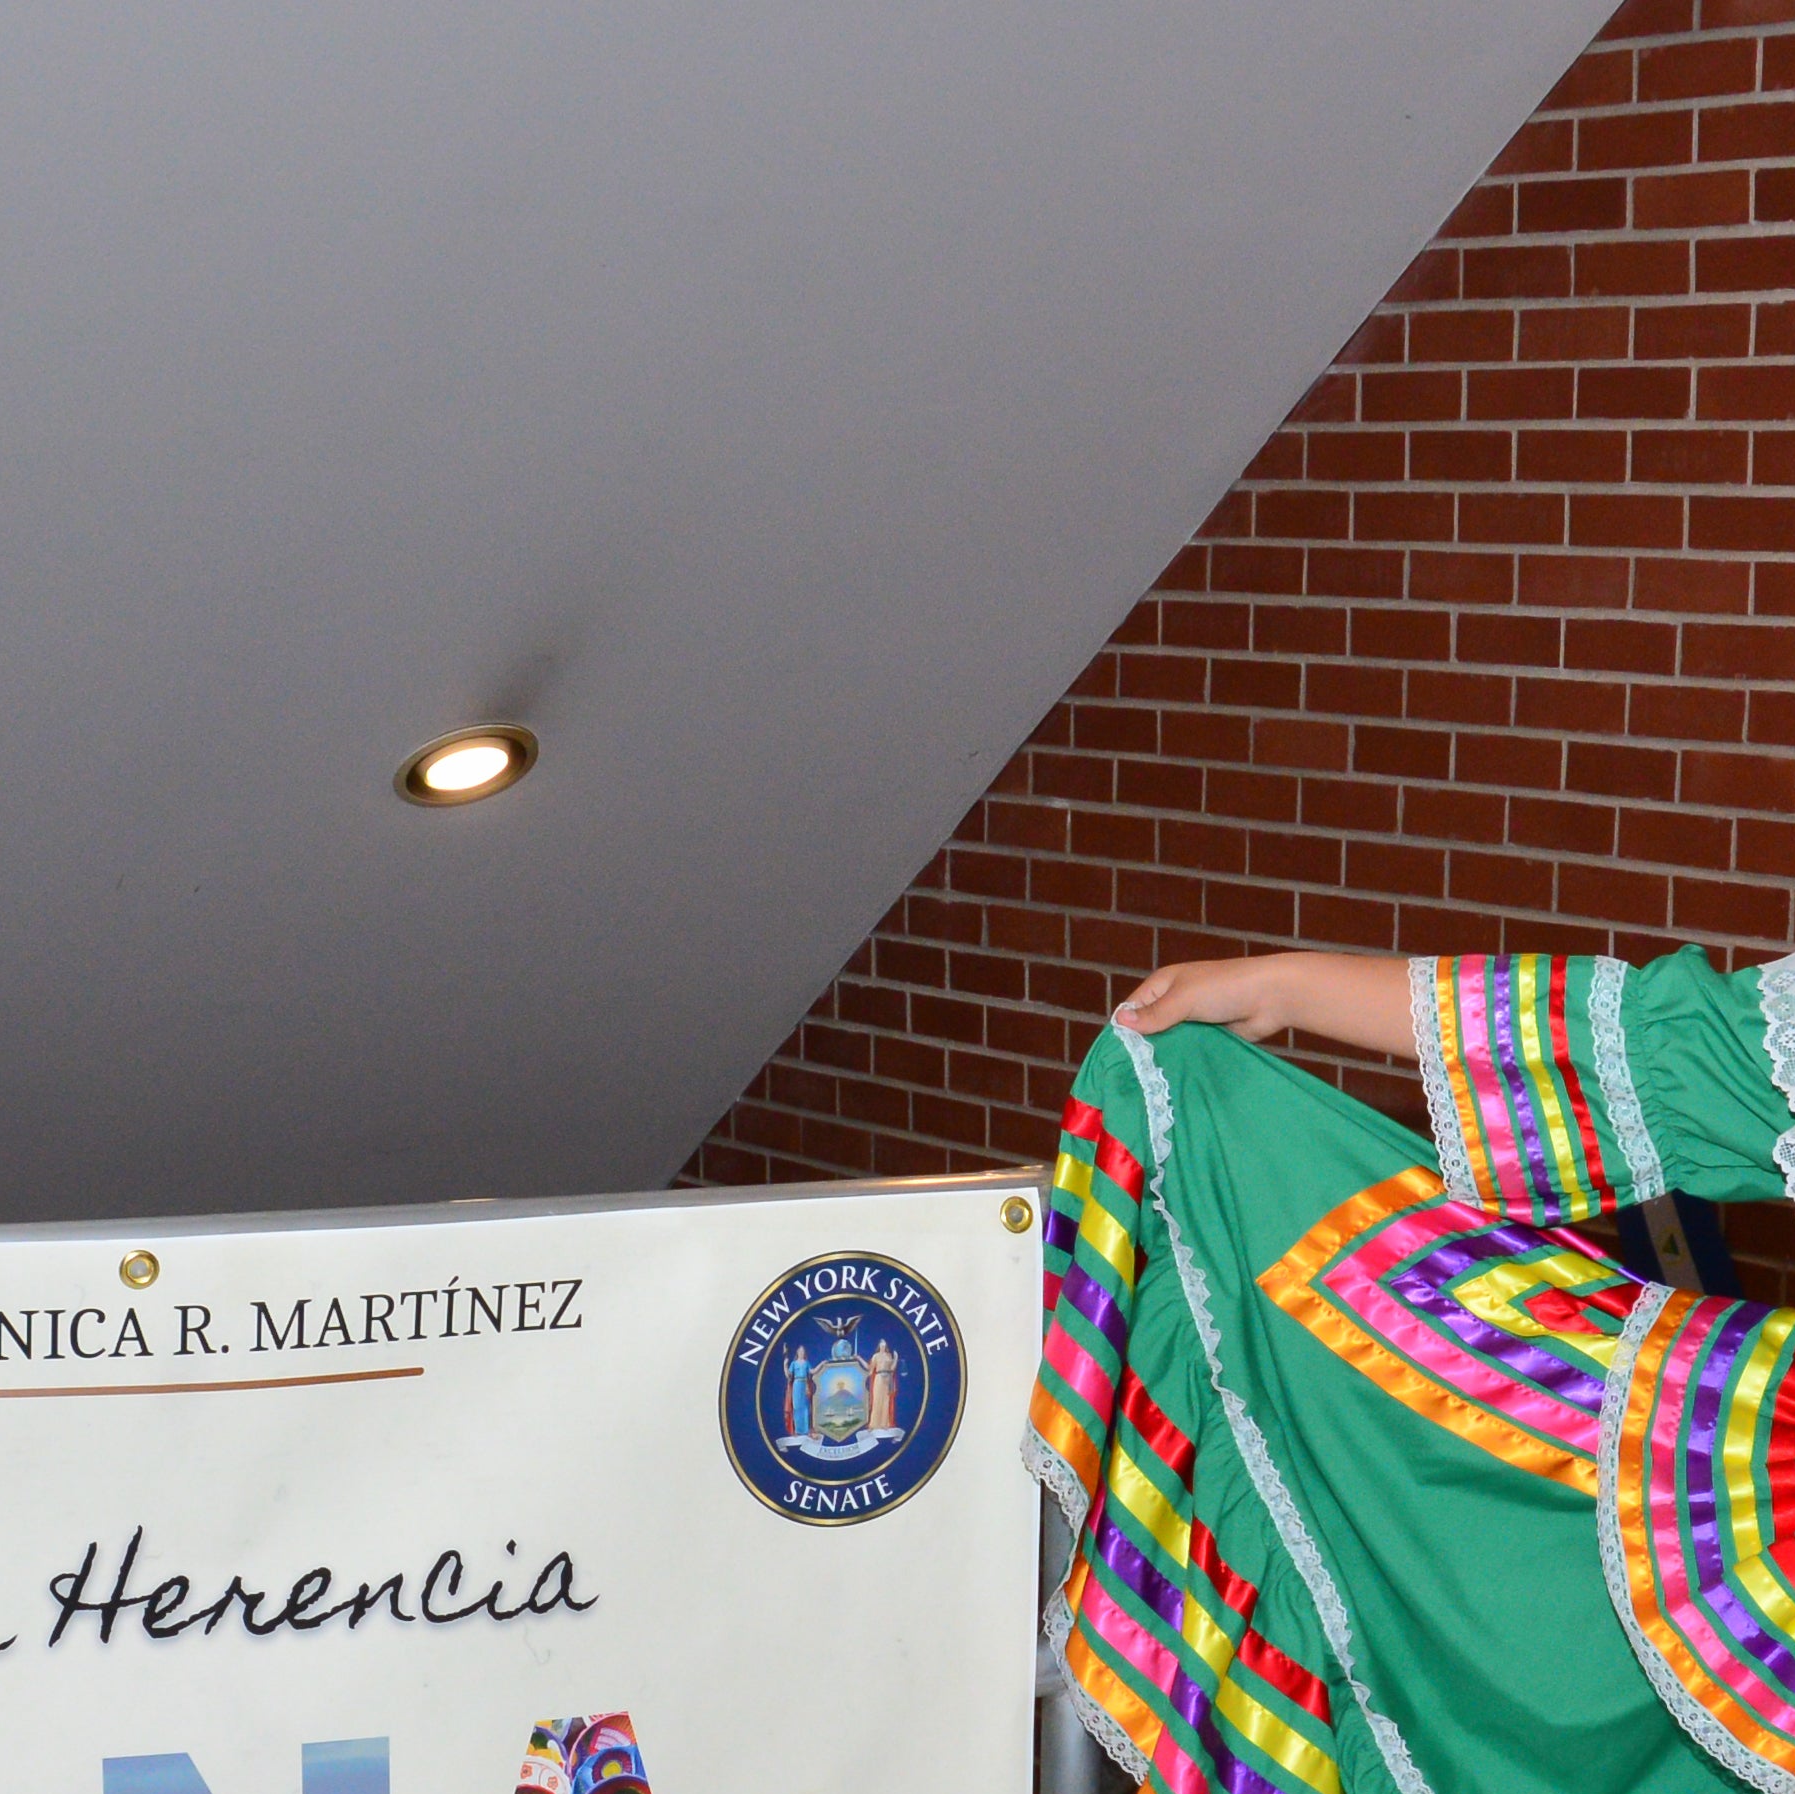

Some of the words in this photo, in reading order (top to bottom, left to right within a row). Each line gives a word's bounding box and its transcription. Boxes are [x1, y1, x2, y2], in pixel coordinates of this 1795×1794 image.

[173, 1303, 230, 1357] R.
[249, 1276, 585, 1353] MARTÍNEZ
[737, 1290, 792, 1367] NEW
[792, 1265, 882, 1301] YORK
[882, 1276, 950, 1356] STATE
[782, 1473, 894, 1513] SENATE
[47, 1524, 601, 1651] Herencia
